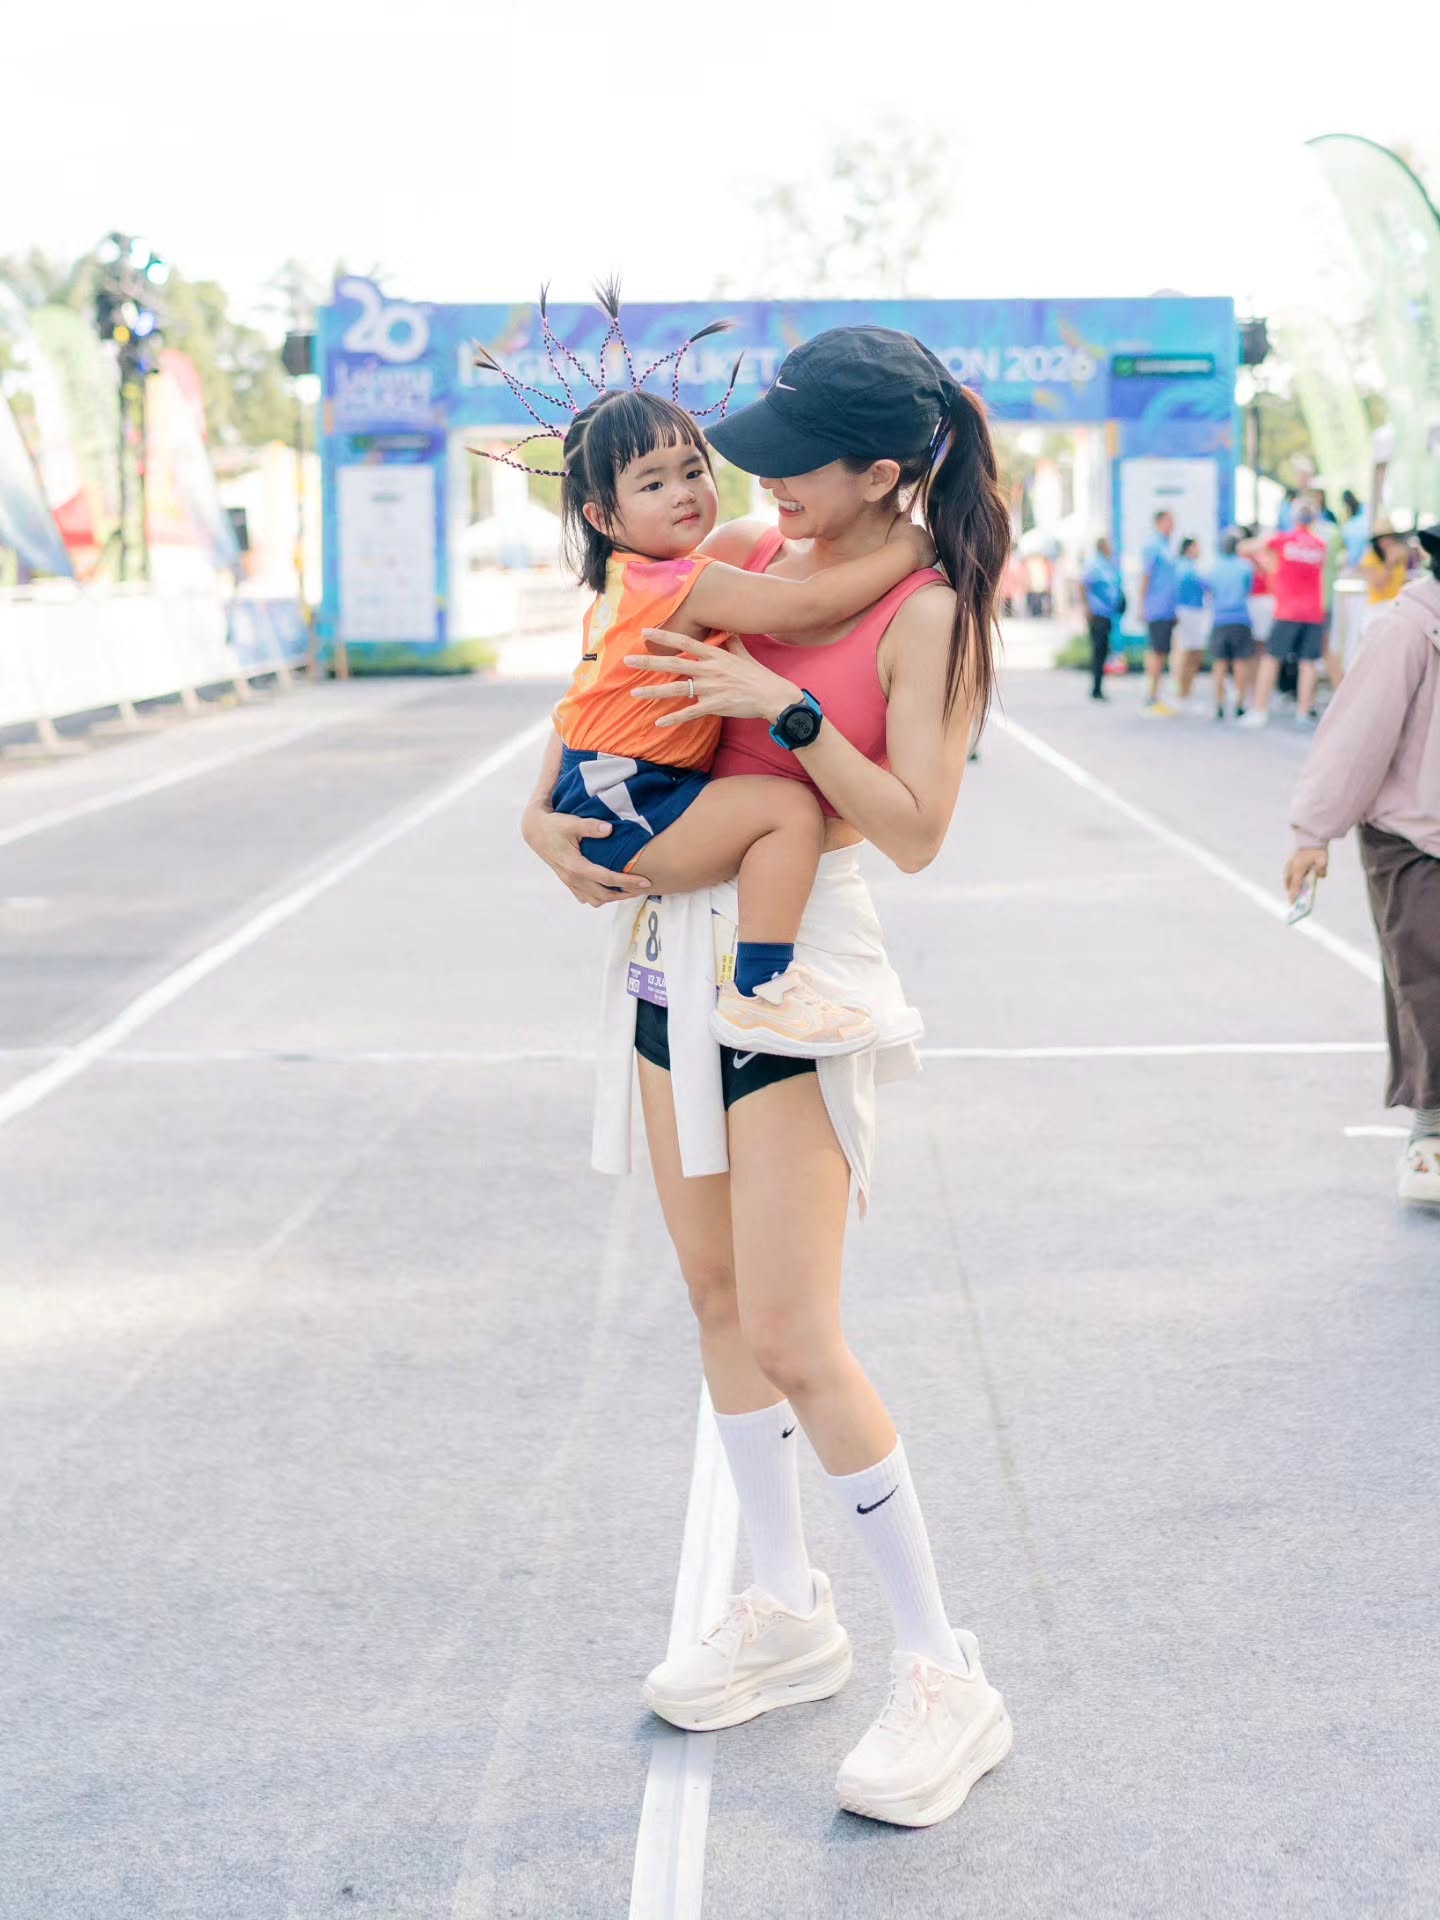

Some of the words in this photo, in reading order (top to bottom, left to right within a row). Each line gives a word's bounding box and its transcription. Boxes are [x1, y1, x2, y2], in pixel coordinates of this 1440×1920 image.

[341, 279, 430, 363] 20
[1004, 346, 1096, 382] 2026
[646, 911, 661, 962] 8
